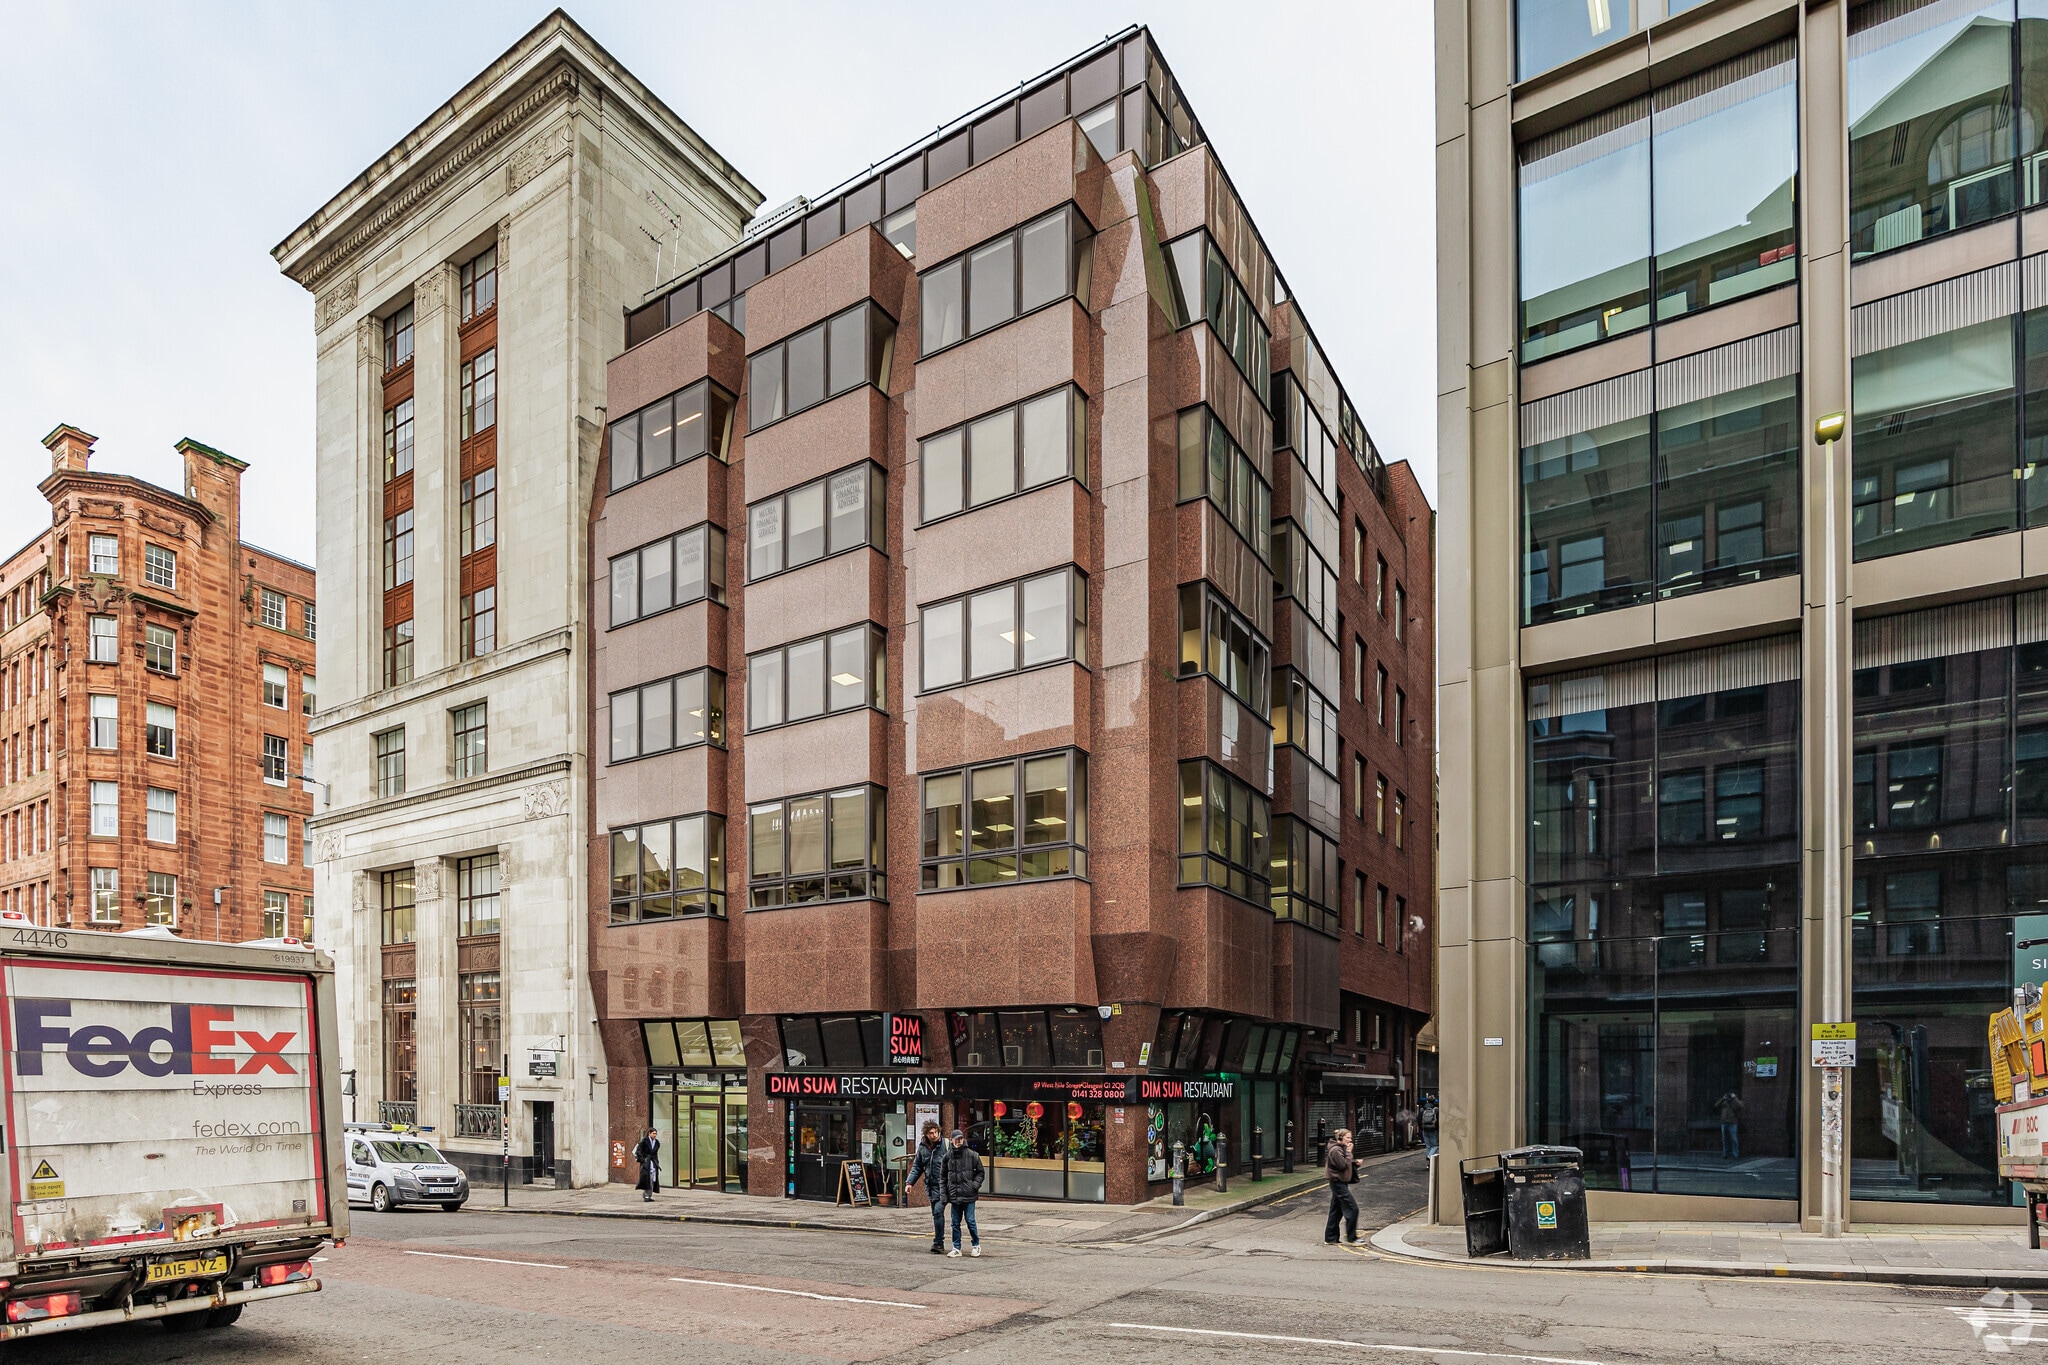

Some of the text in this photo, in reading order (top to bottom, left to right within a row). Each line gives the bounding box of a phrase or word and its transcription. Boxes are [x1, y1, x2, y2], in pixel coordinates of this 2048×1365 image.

[12, 930, 68, 949] 4446
[892, 1016, 920, 1036] DIM
[16, 1000, 298, 1078] FedEx
[890, 1036, 922, 1055] SUM
[193, 1080, 262, 1099] Express
[771, 1077, 948, 1095] DIM SUM RESTAURANT
[1142, 1081, 1233, 1098] DIM SUM RESTAURANT
[192, 1120, 300, 1138] fedex.com
[2026, 1116, 2038, 1133] BOC
[195, 1142, 302, 1156] The World On Time
[154, 1260, 217, 1278] DA15 JYZ
